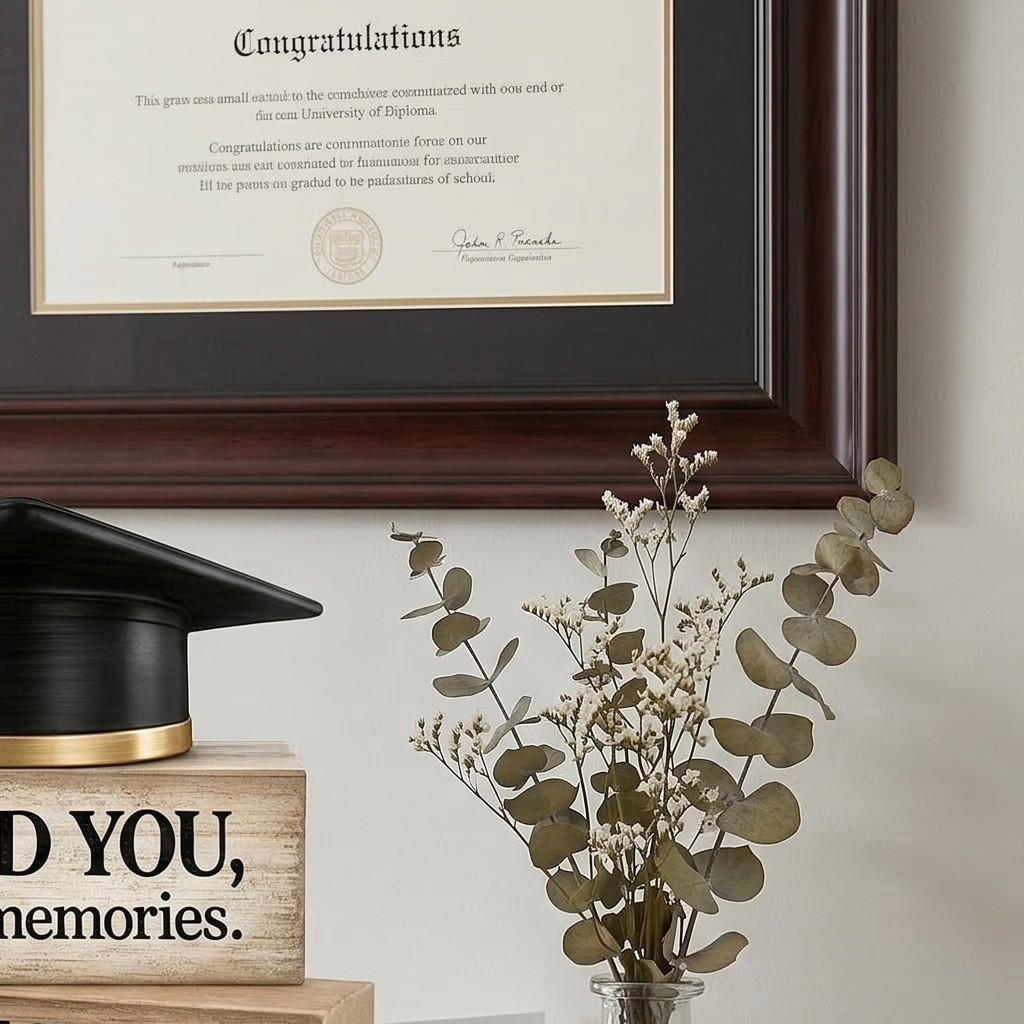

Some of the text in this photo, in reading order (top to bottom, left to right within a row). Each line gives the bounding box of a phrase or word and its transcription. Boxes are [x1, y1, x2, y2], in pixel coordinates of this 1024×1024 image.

[233, 24, 461, 62] Congratulations
[306, 90, 324, 101] the
[471, 82, 496, 95] with
[369, 105, 383, 117] of
[209, 140, 301, 156] Congratulations
[304, 141, 322, 151] are
[449, 136, 463, 146] on
[467, 136, 487, 146] our
[335, 178, 346, 187] to
[438, 172, 451, 184] of
[76, 810, 245, 887] YOU,
